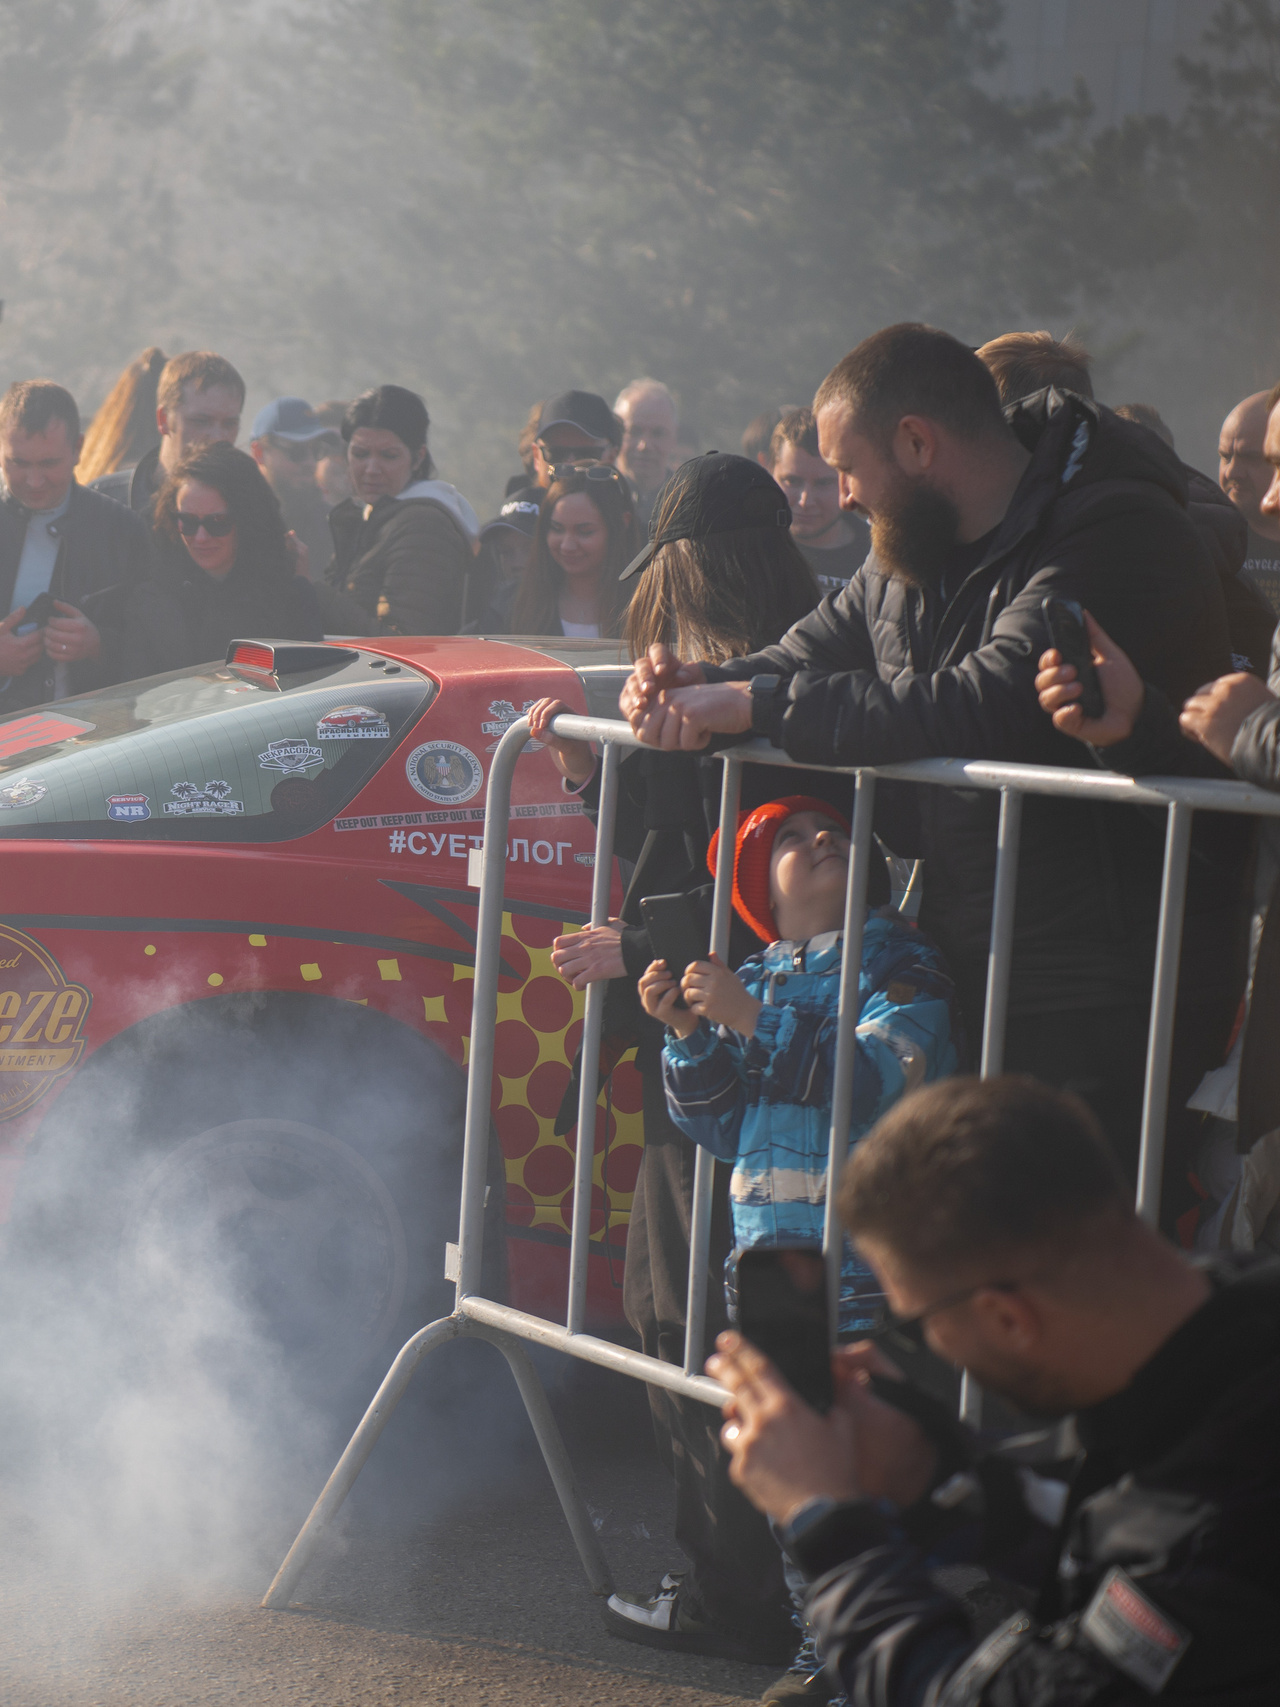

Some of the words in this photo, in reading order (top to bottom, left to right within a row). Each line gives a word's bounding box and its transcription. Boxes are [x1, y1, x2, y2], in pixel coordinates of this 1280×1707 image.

[487, 722, 510, 731] NIG
[260, 747, 321, 761] НЕКРАСОВКА
[409, 747, 427, 776] NATIONAL
[428, 743, 463, 753] SECURITY
[463, 752, 480, 776] AGENCY
[417, 783, 434, 797] UNITED
[115, 805, 144, 816] NR
[168, 801, 201, 810] NIGHT
[335, 819, 359, 830] KEEP
[360, 817, 378, 828] OUT
[380, 815, 404, 826] KEEP
[405, 813, 422, 825] OUT
[425, 812, 449, 823] KEEP
[450, 810, 467, 821] OUT
[470, 808, 485, 820] KE
[515, 806, 538, 817] KEEP
[540, 805, 557, 816] OUT
[389, 830, 572, 865] #СУЕТЛОГ
